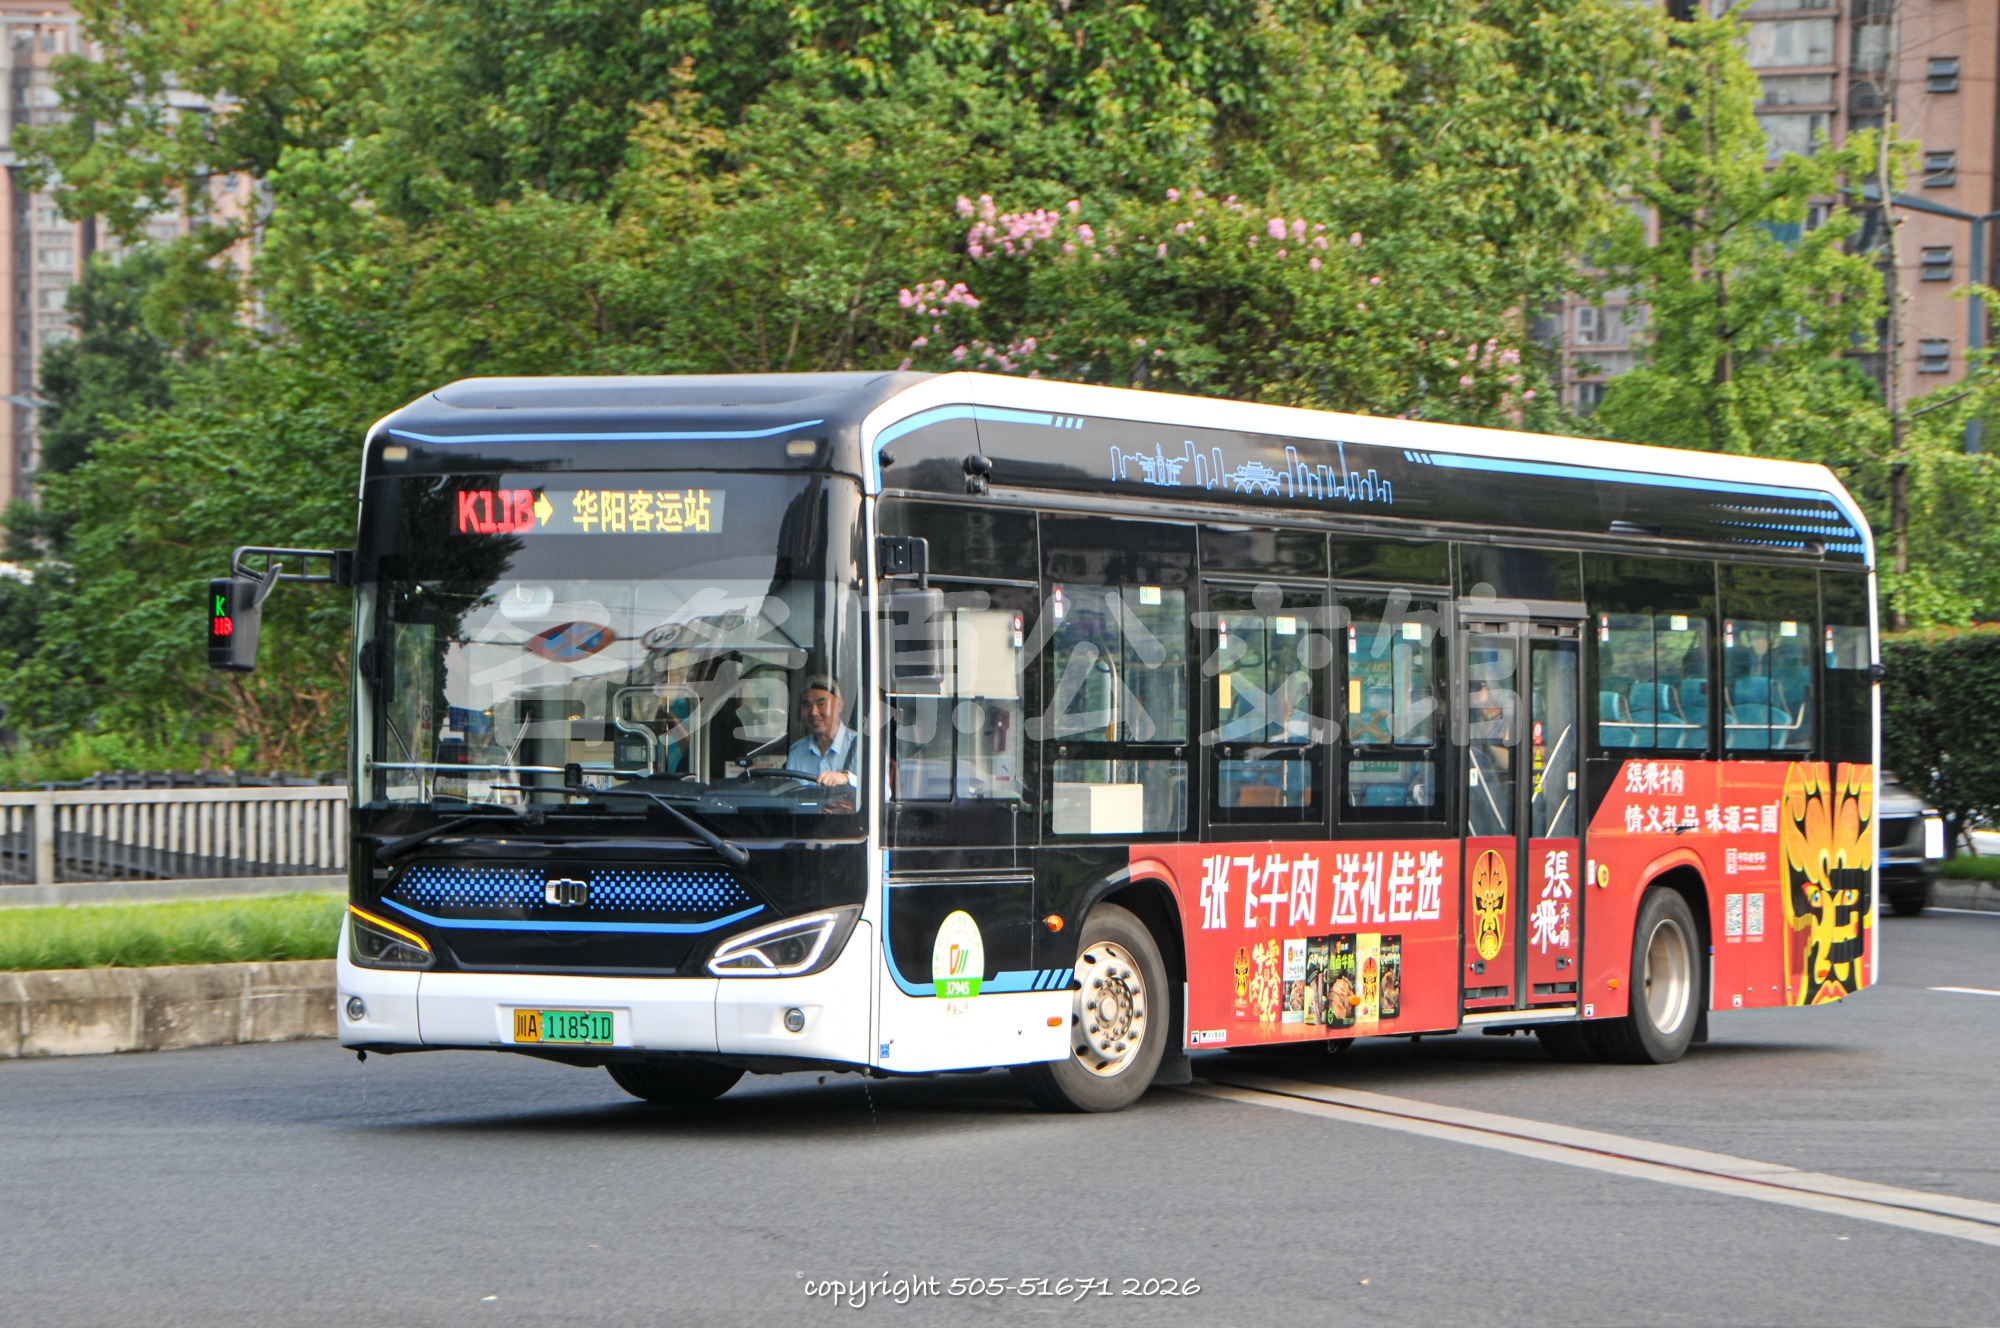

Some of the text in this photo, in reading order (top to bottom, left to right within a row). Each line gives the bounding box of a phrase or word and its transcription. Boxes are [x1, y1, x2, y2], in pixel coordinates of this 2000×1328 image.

[458, 489, 535, 533] K11B
[572, 489, 711, 532] 华阳客运站
[216, 595, 225, 616] K
[1624, 804, 1699, 833] 情义礼品
[1200, 850, 1443, 929] 张飞牛肉 送礼佳选
[945, 981, 970, 996] 37945
